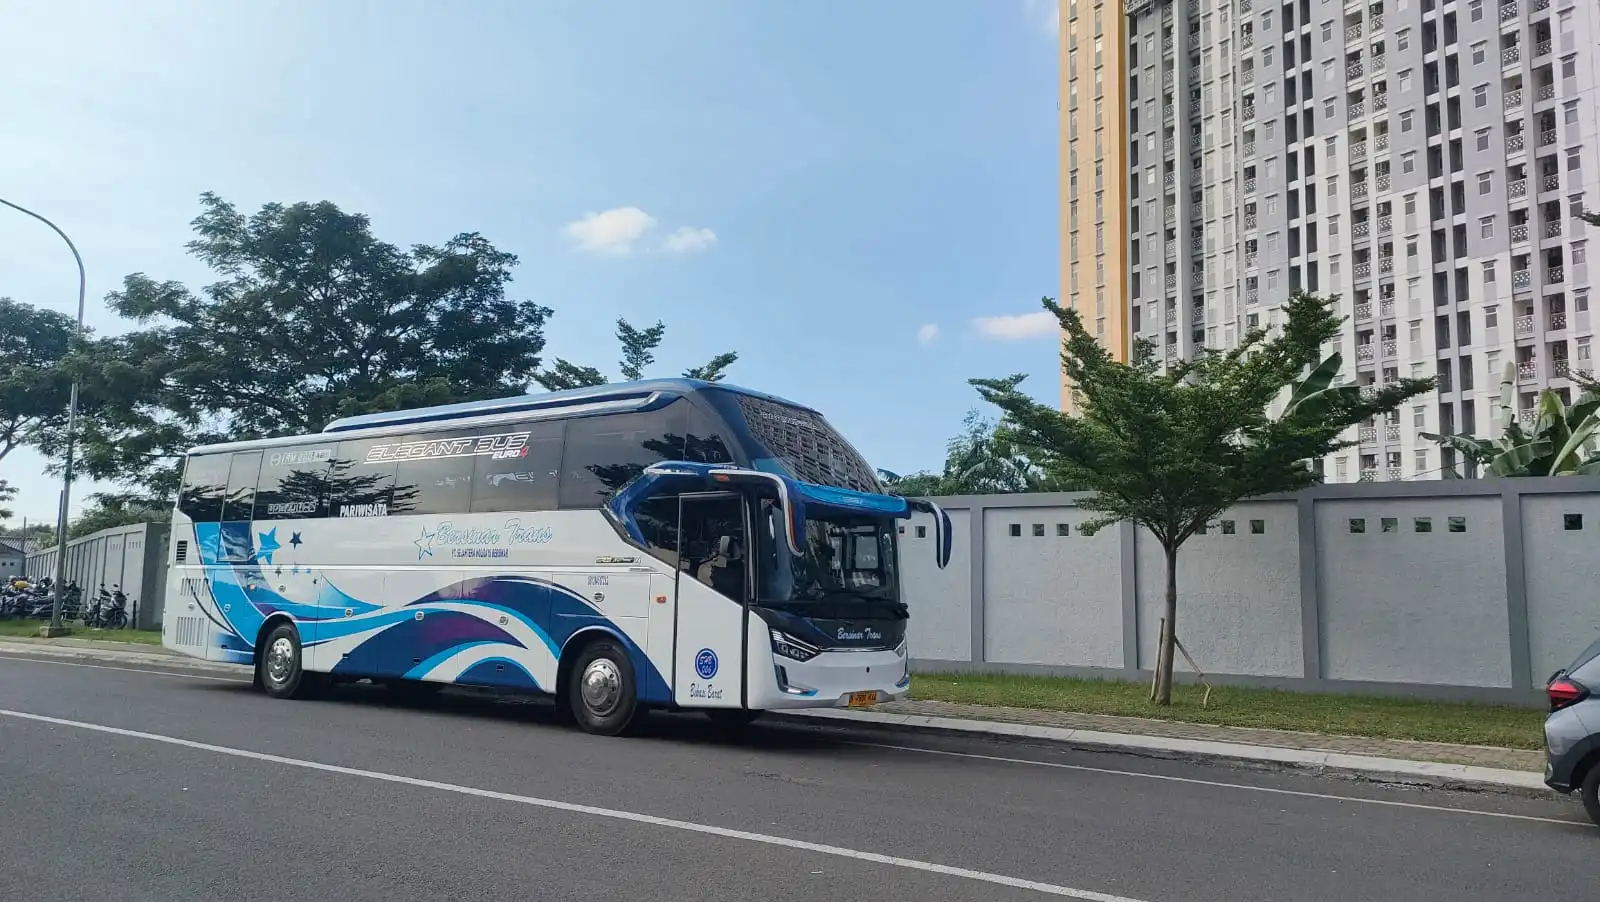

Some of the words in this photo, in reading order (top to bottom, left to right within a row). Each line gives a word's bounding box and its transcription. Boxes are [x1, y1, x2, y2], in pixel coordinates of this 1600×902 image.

[366, 439, 472, 462] ELEGANT
[474, 434, 530, 452] BUS
[340, 503, 388, 517] PARIWISATA
[437, 520, 500, 545] Bersinar
[504, 517, 553, 545] Trans
[837, 627, 864, 640] Bersinar
[865, 627, 882, 640] Trans
